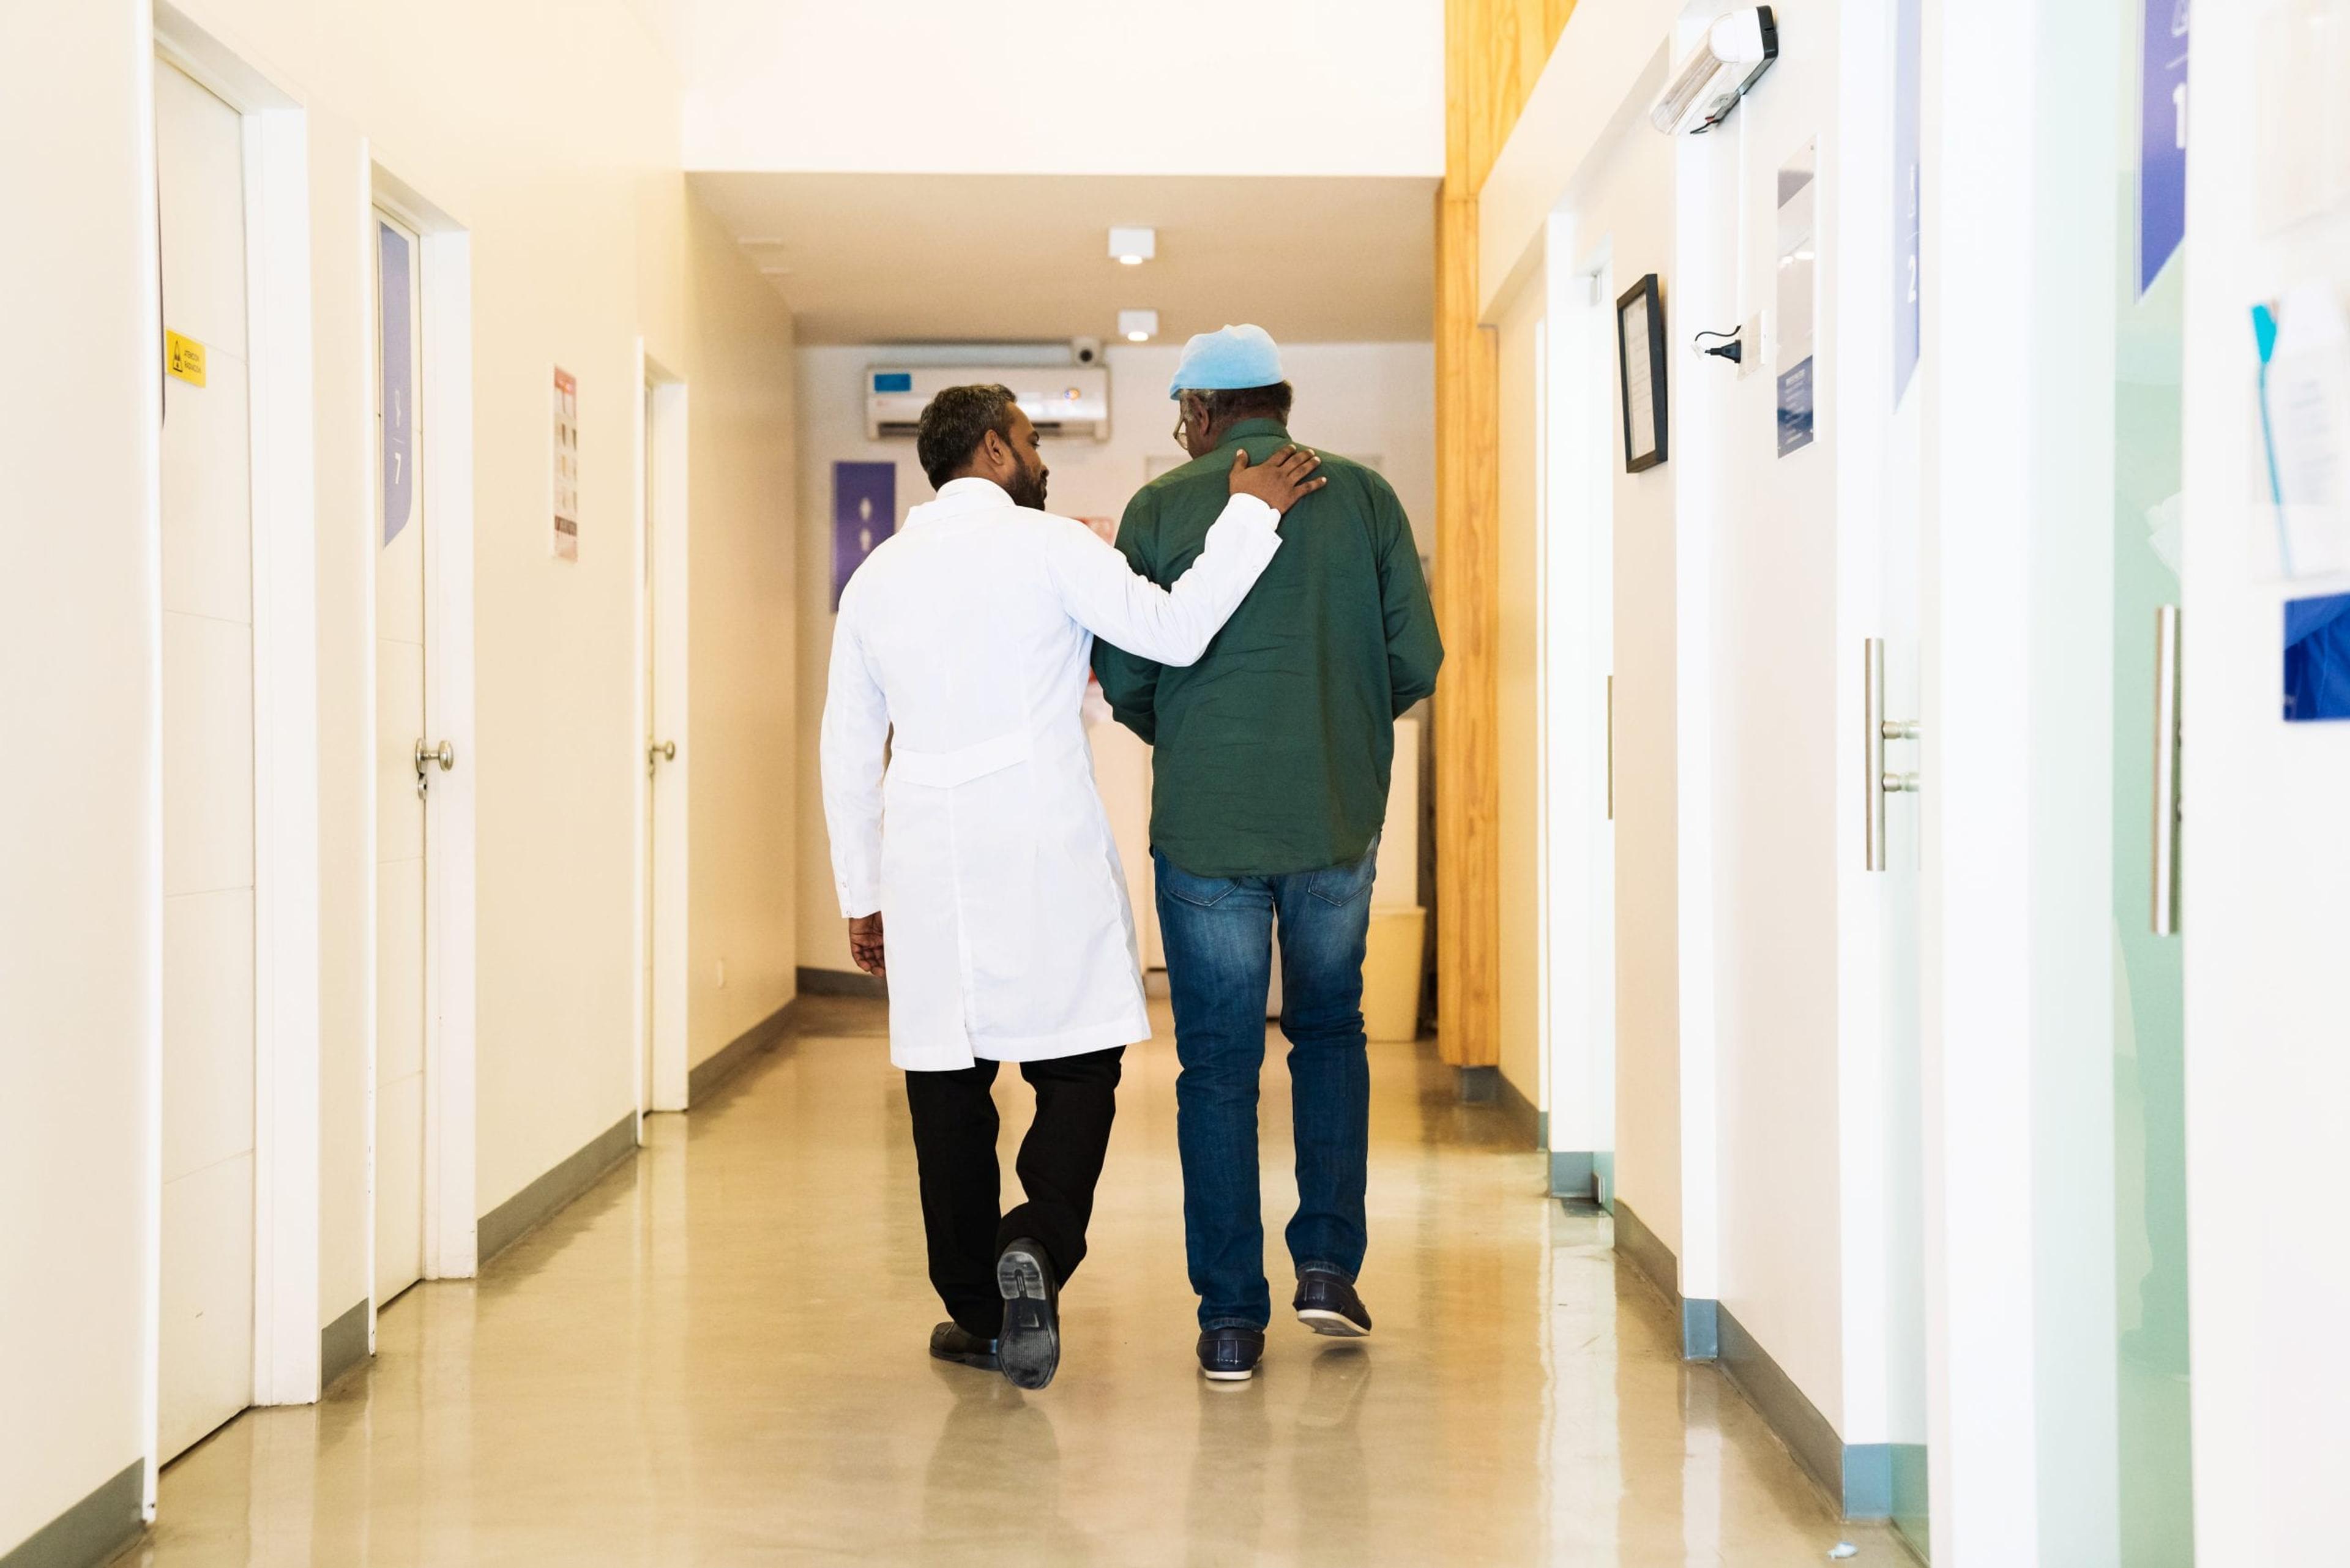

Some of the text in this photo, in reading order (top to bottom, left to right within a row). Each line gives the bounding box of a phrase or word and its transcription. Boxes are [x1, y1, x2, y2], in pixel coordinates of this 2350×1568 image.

[2173, 82, 2187, 149] 1
[1908, 254, 1916, 304] 2
[395, 452, 401, 485] 7
